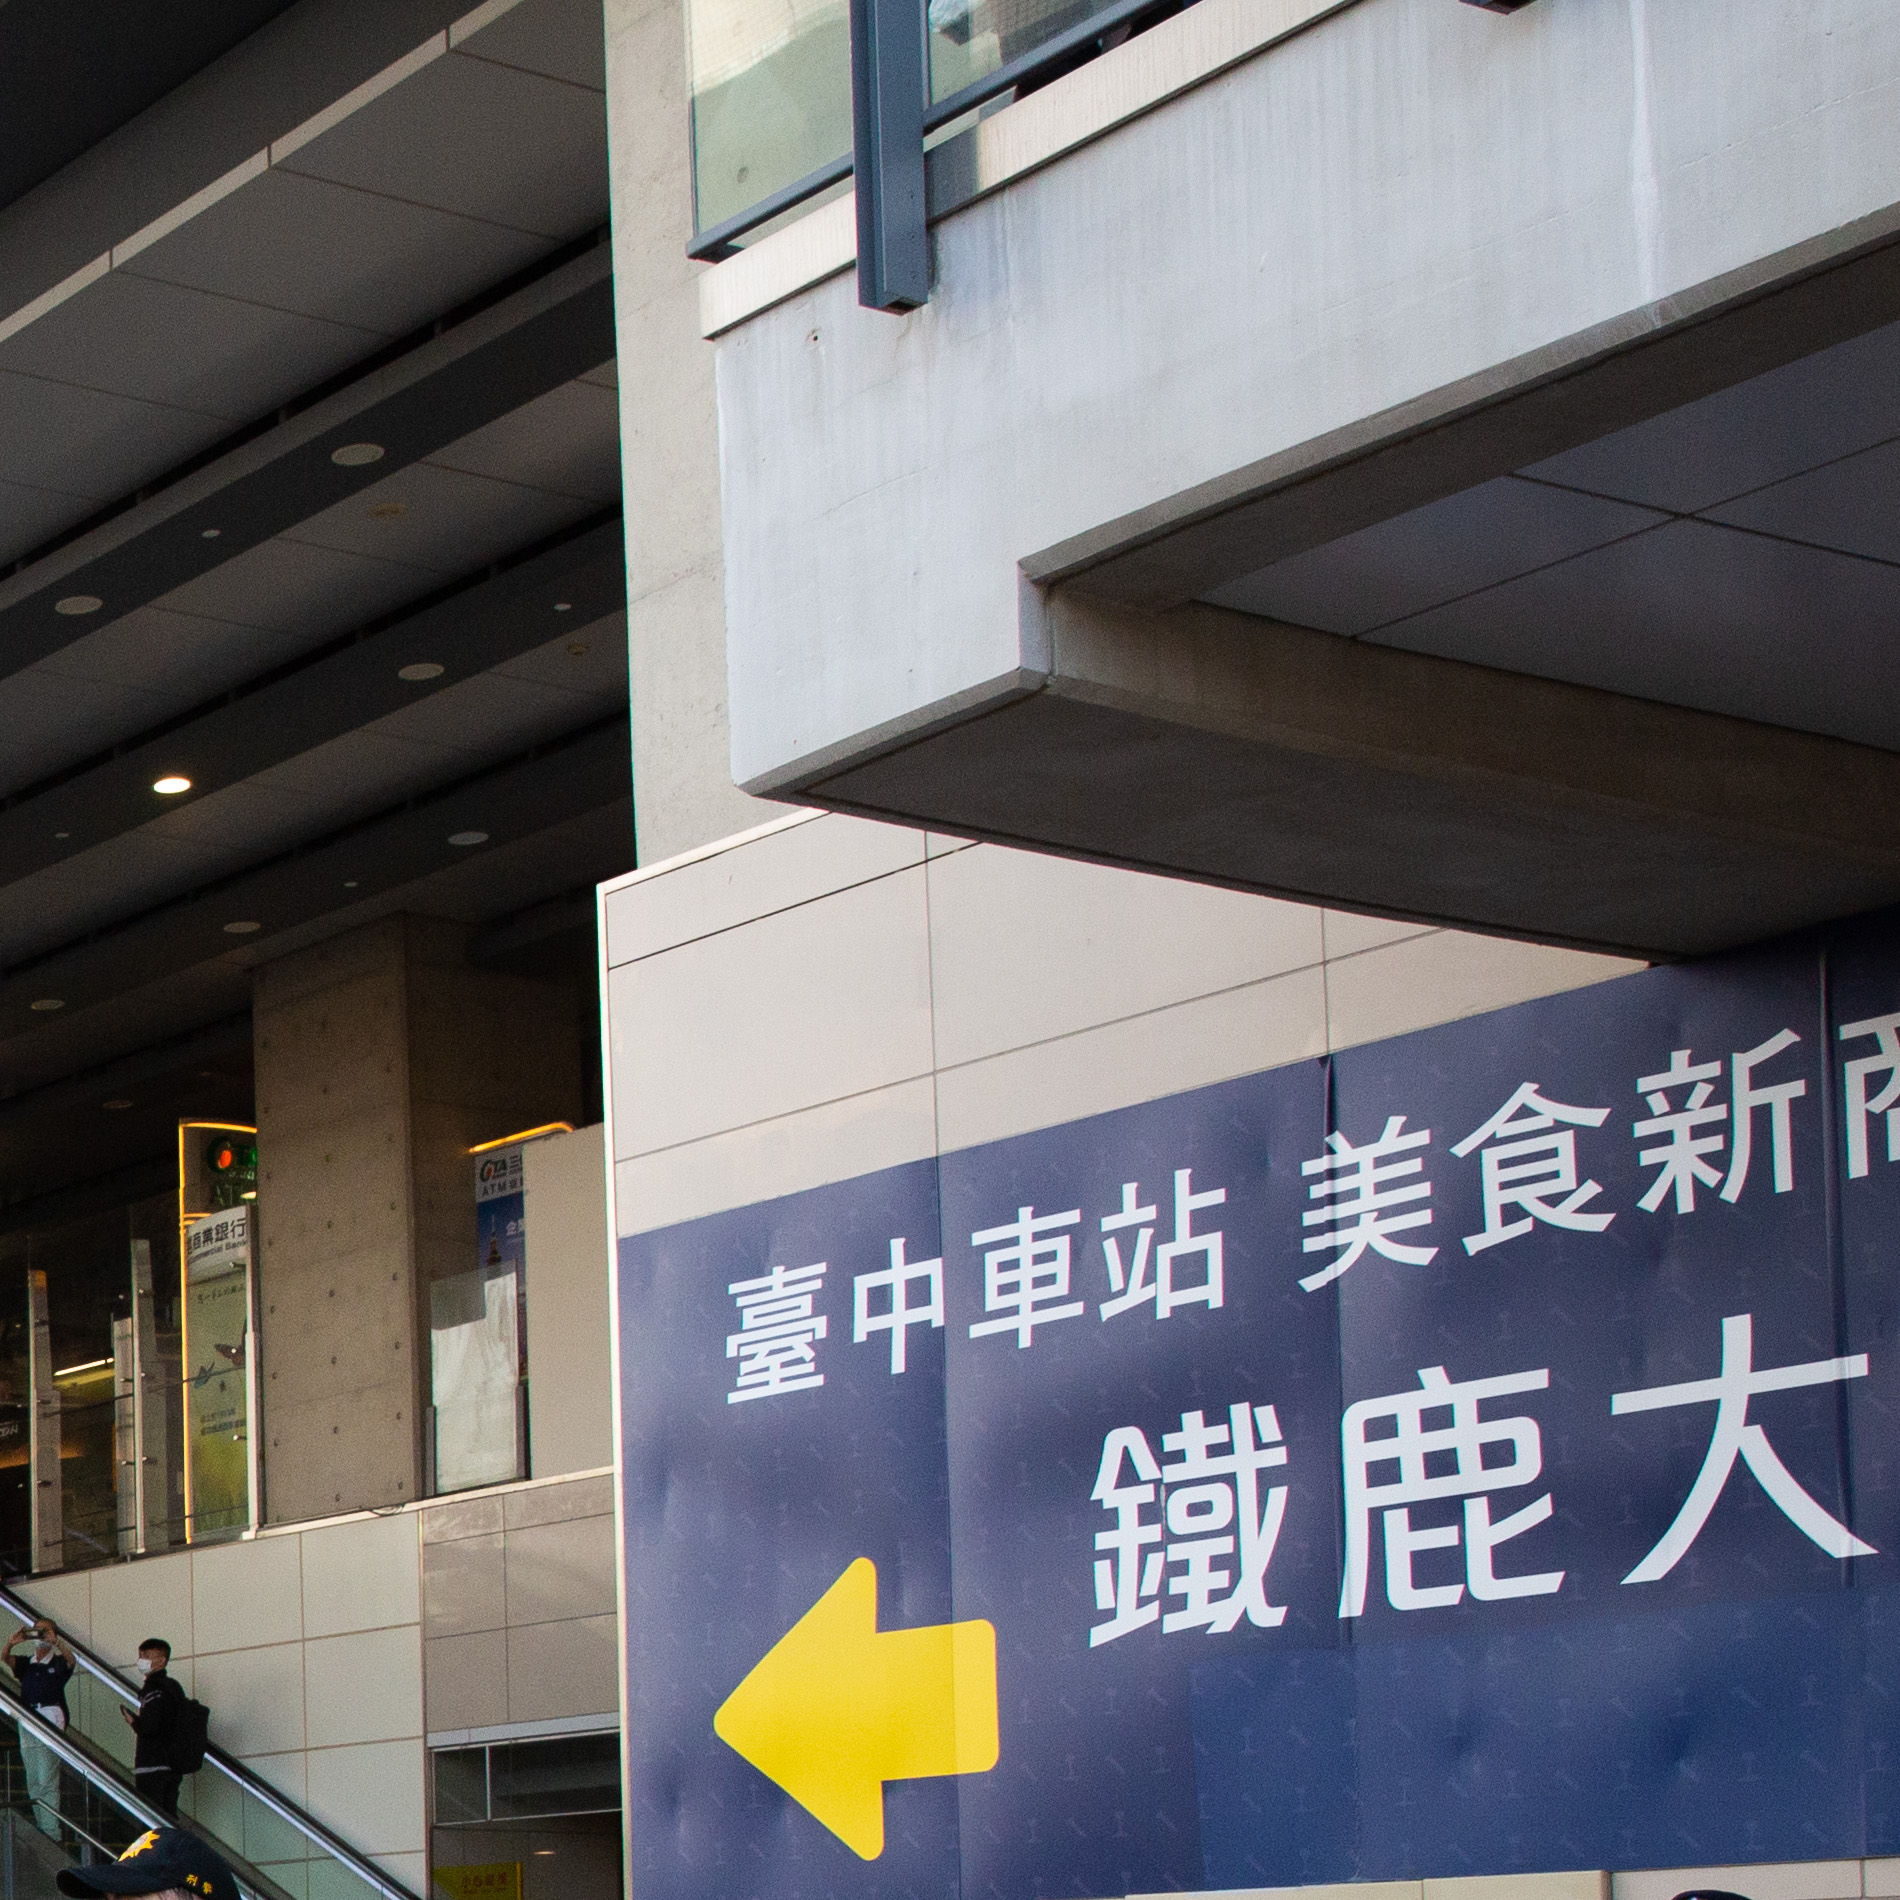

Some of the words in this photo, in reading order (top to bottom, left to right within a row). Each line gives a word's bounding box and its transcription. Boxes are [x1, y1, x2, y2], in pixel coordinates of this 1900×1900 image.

[726, 1169, 1225, 1405] 臺中車站
[1090, 1313, 1877, 1648] 鐵鹿大
